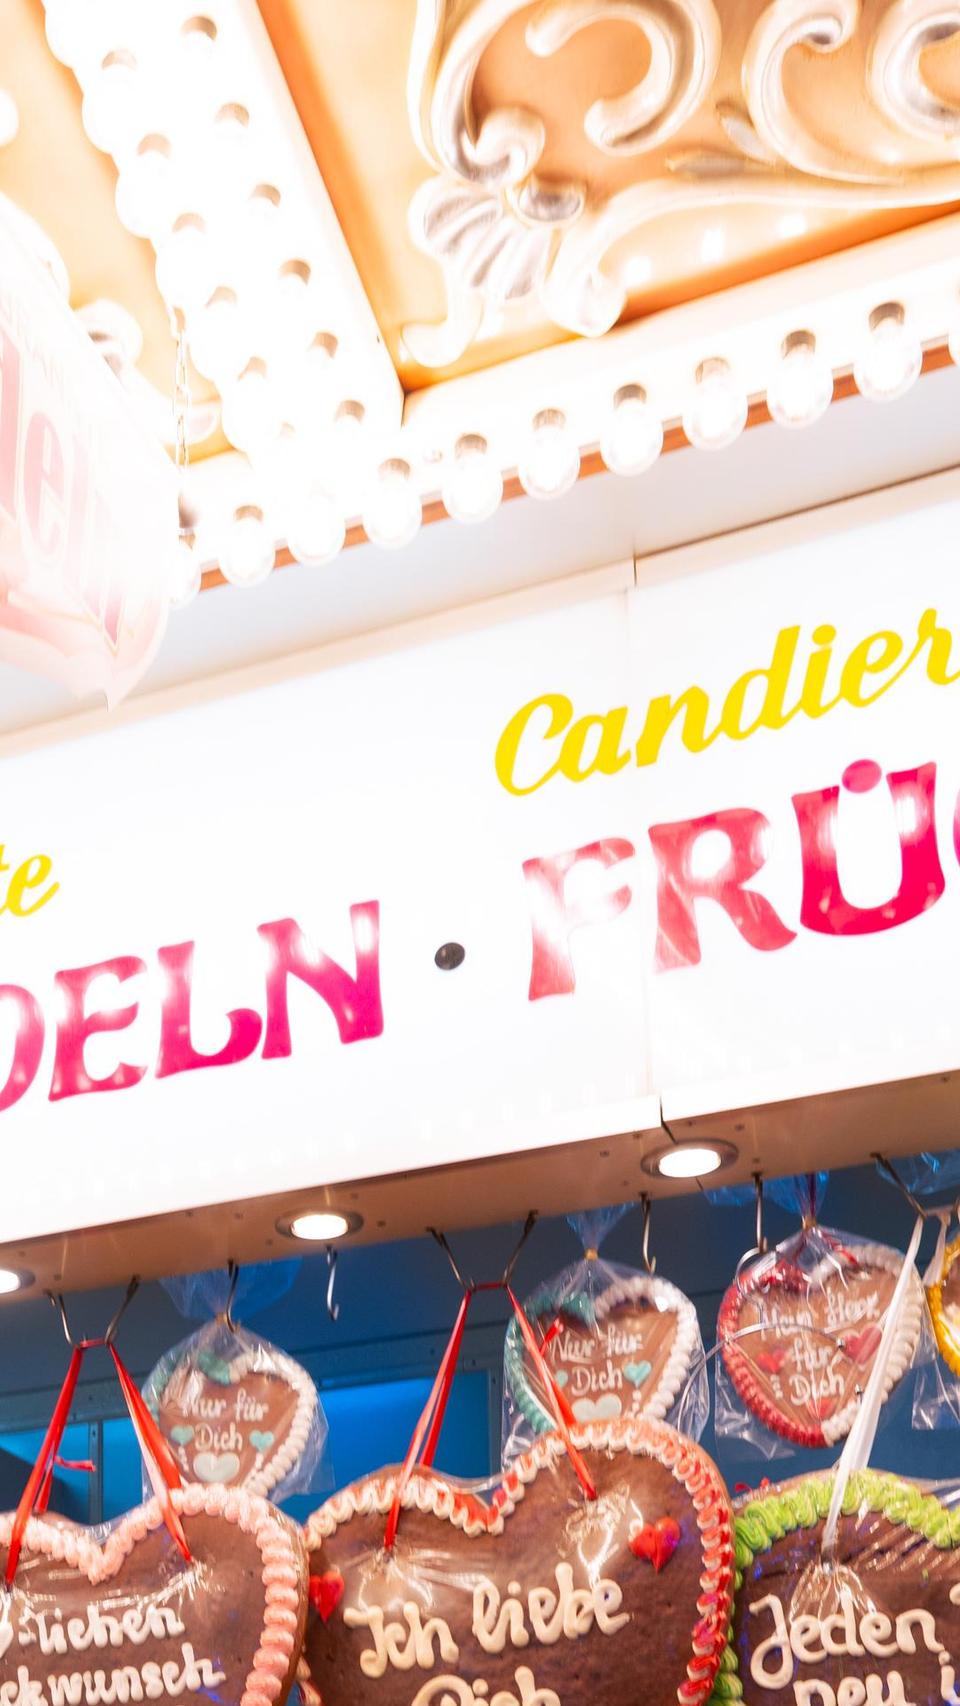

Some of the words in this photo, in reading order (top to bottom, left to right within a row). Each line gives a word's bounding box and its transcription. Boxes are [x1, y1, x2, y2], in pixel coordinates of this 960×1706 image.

[521, 757, 960, 1003] FRÜ
[548, 1331, 596, 1365] Nur
[602, 1325, 644, 1361] für
[571, 1359, 624, 1397] Dich
[233, 1387, 269, 1424] für
[194, 1421, 243, 1451] Dich
[471, 1561, 634, 1654] liebe
[748, 1583, 945, 1691] Jeden
